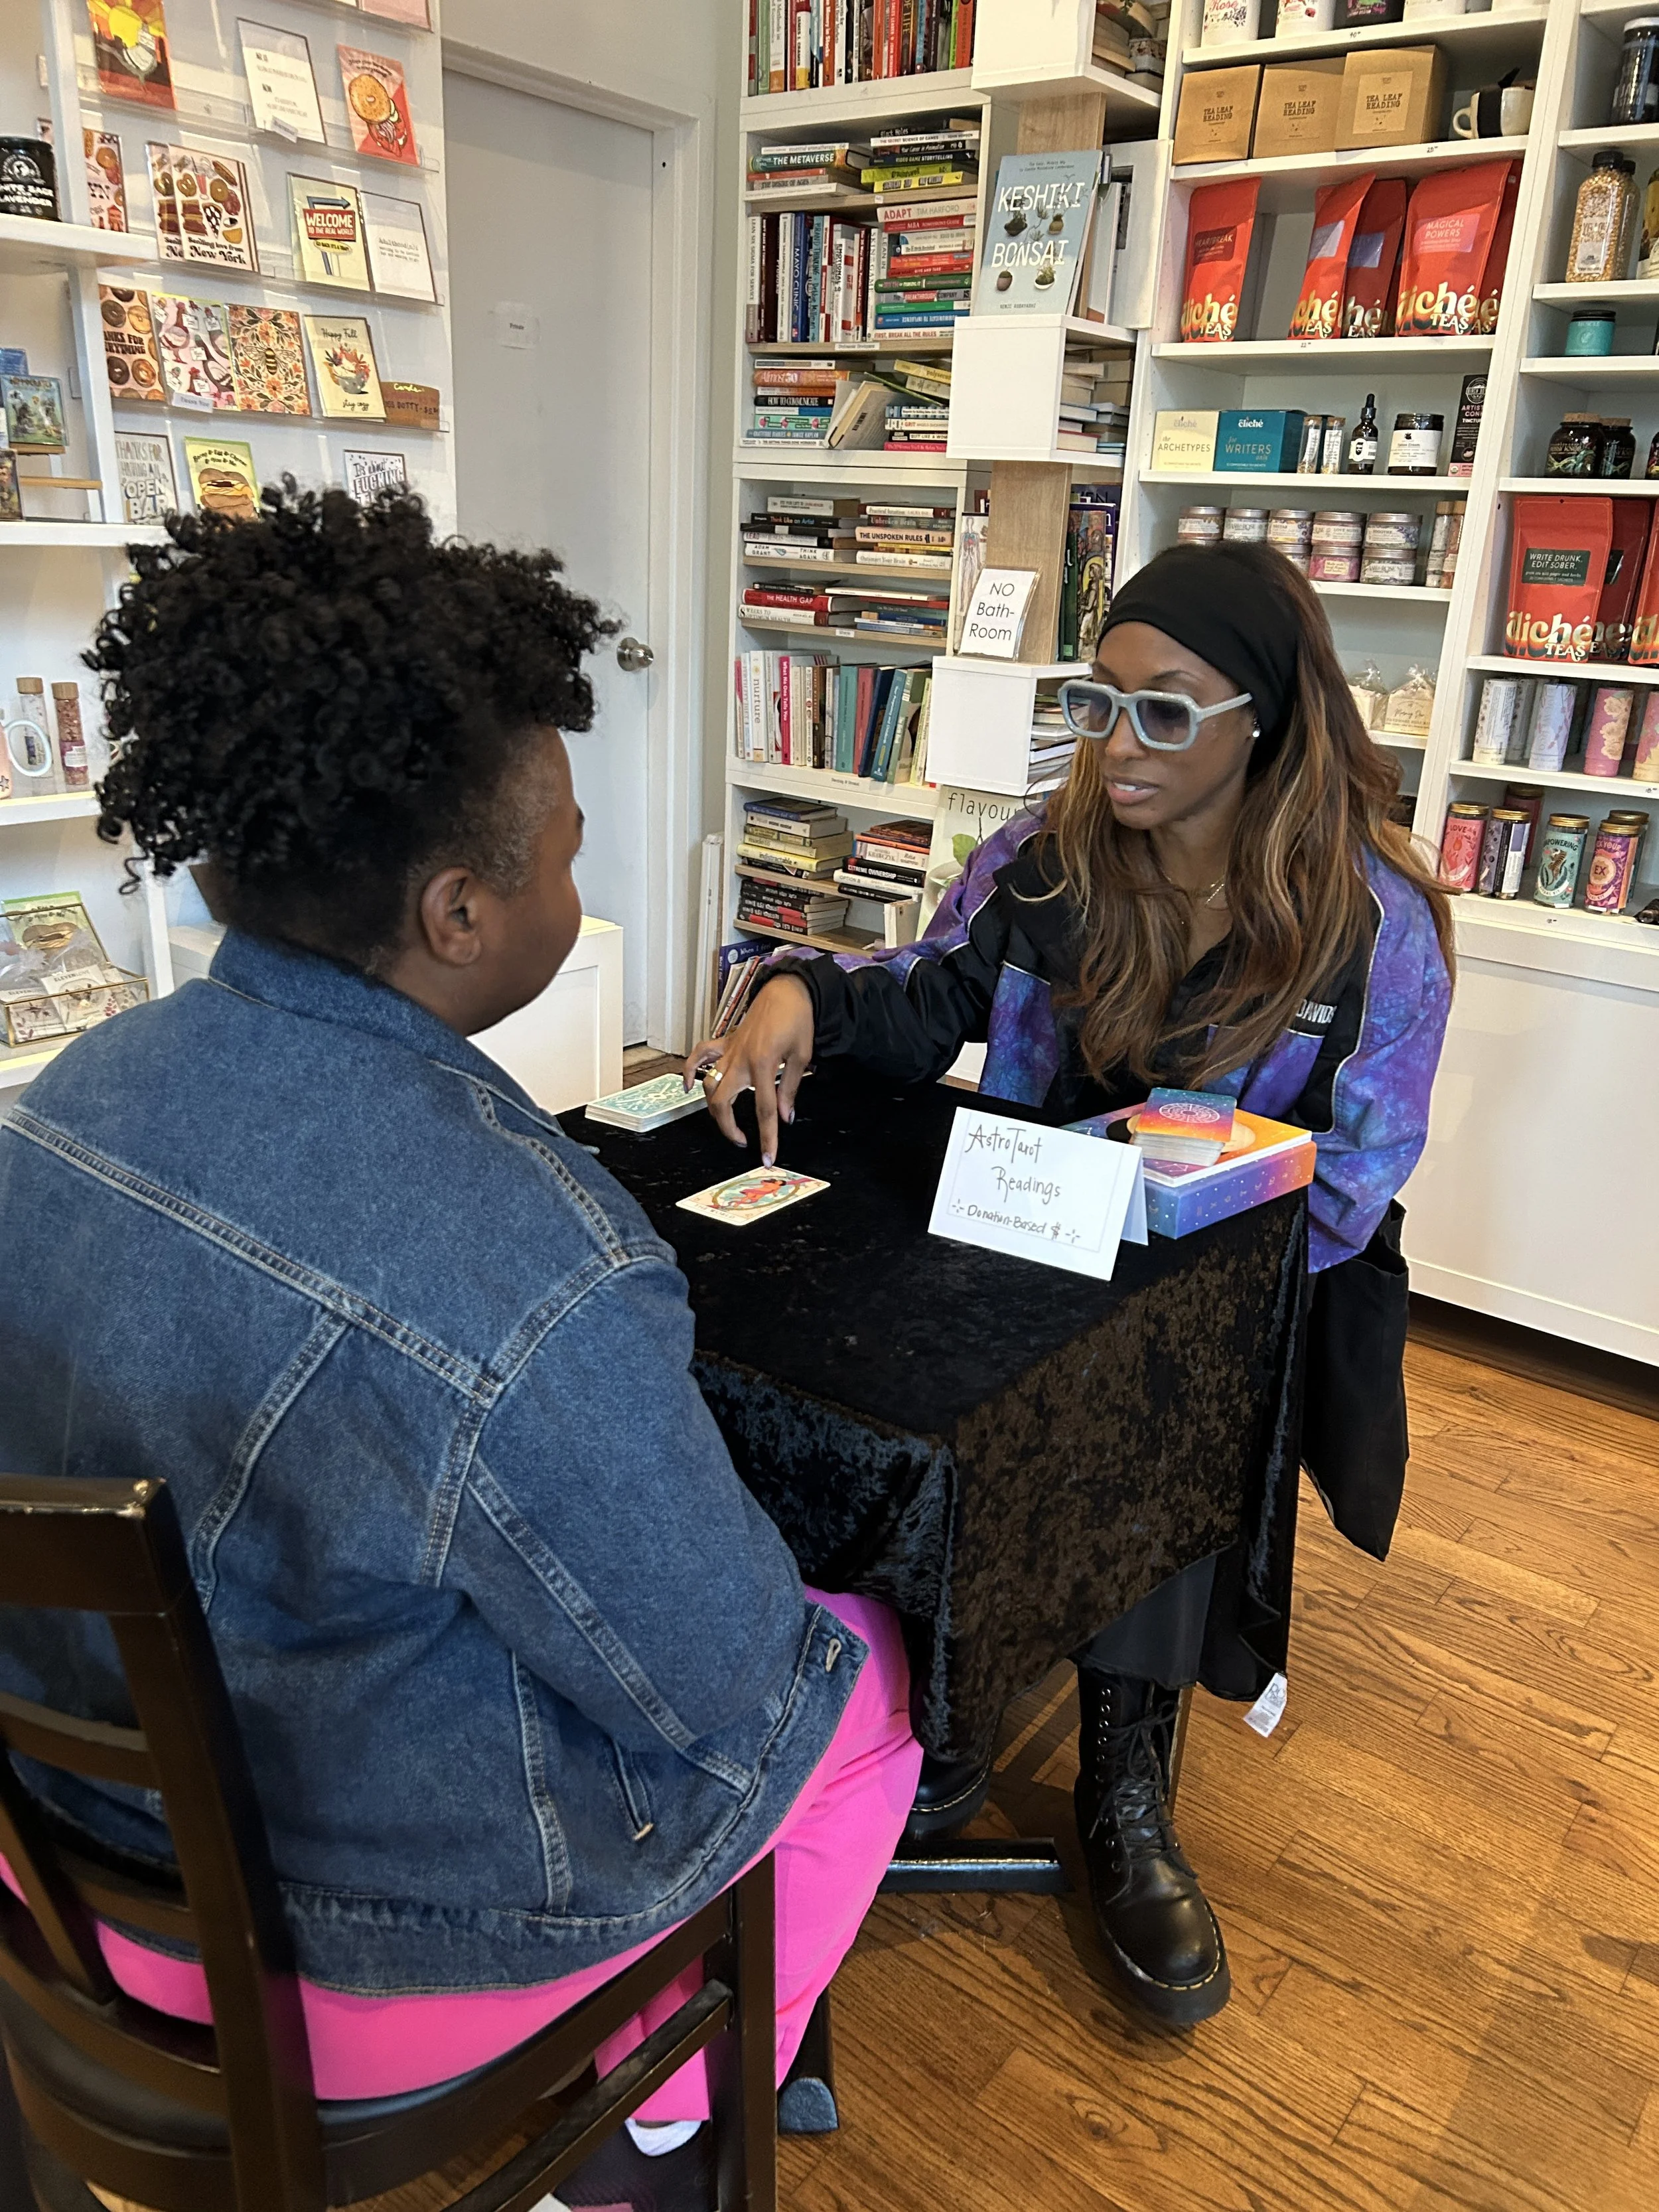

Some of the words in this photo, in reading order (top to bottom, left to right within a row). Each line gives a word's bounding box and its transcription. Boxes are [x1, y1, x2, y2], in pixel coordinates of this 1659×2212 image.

[902, 13, 911, 35] LIFE
[1216, 106, 1233, 114] LEAF
[1297, 100, 1316, 109] LEAF
[1366, 100, 1401, 110] READING
[1203, 113, 1233, 123] READING
[1283, 108, 1315, 117] READING
[773, 156, 788, 165] THE
[790, 153, 835, 165] METAVERSE
[997, 181, 1085, 212] KESHIKI
[884, 208, 912, 220] ADAPT
[916, 208, 928, 216] TIM
[929, 204, 960, 215] HARFORD
[306, 212, 353, 228] WELCOME
[1426, 219, 1465, 229] MAGICAL
[1425, 228, 1461, 239] POWERS
[188, 237, 214, 249] Sending
[228, 244, 244, 252] from
[190, 245, 216, 259] New
[219, 250, 248, 264] York
[991, 240, 1069, 267] BONSAI
[881, 261, 887, 269] IN
[1430, 313, 1470, 335] TEAS
[321, 328, 341, 341] Happy
[343, 329, 357, 338] Fall
[342, 399, 355, 410] stay
[357, 401, 369, 411] cozy
[768, 396, 778, 406] HOW
[779, 397, 786, 406] TO
[786, 397, 819, 407] COMMUNICATE
[1238, 417, 1263, 428] cliché
[115, 440, 148, 460] THANKS
[1157, 443, 1212, 453] ARCHETYPES
[1225, 443, 1272, 455] WRITERS
[353, 467, 405, 498] FUCKING
[125, 479, 166, 499] OPEN
[871, 517, 899, 526] Unbroken
[1530, 553, 1553, 561] WRITE
[1555, 554, 1583, 563] DRUNK.
[1532, 560, 1549, 569] EDIT
[1550, 561, 1577, 570] SOBER.
[989, 582, 1015, 597] NO
[775, 594, 797, 603] HEALTH
[976, 602, 1015, 619] Bath-
[969, 623, 1012, 641] Room
[1545, 642, 1586, 662] TEAS
[782, 676, 788, 685] No
[753, 679, 762, 724] nurture
[1449, 824, 1467, 834] LOVE
[1604, 841, 1622, 851] YOUR
[847, 864, 868, 875] EXTREME
[868, 868, 897, 880] OWNERSHIP
[1594, 865, 1606, 875] EX
[740, 947, 755, 956] When
[964, 1124, 1044, 1164] AstroTarot
[991, 1165, 1062, 1205] Readings
[710, 1209, 736, 1219] WORLD
[1050, 1221, 1062, 1240] $
